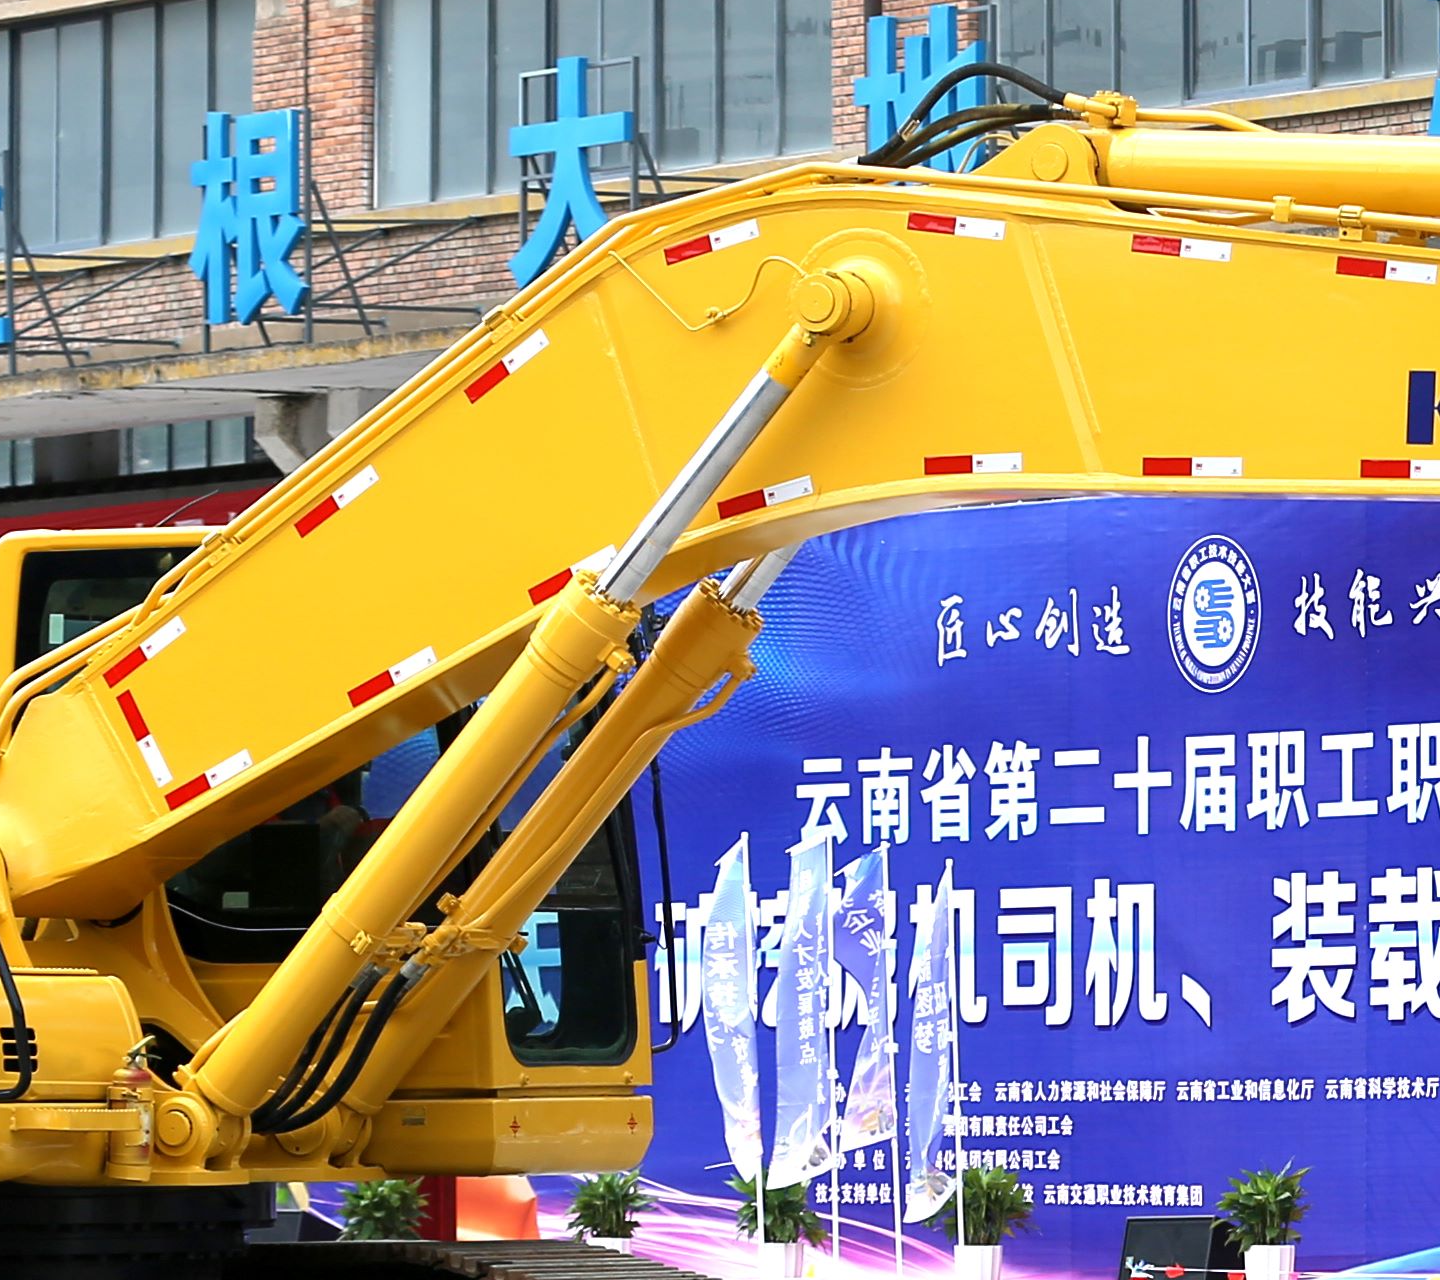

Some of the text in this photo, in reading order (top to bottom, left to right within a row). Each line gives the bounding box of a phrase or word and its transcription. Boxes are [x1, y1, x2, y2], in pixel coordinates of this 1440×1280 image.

[937, 584, 1133, 668] 匠心创造
[1175, 1077, 1315, 1103] 云南省工业和信息化厅
[1324, 1075, 1440, 1101] 云南省科学技术厅
[1043, 1182, 1203, 1208] 云南交通职业技术教育集团
